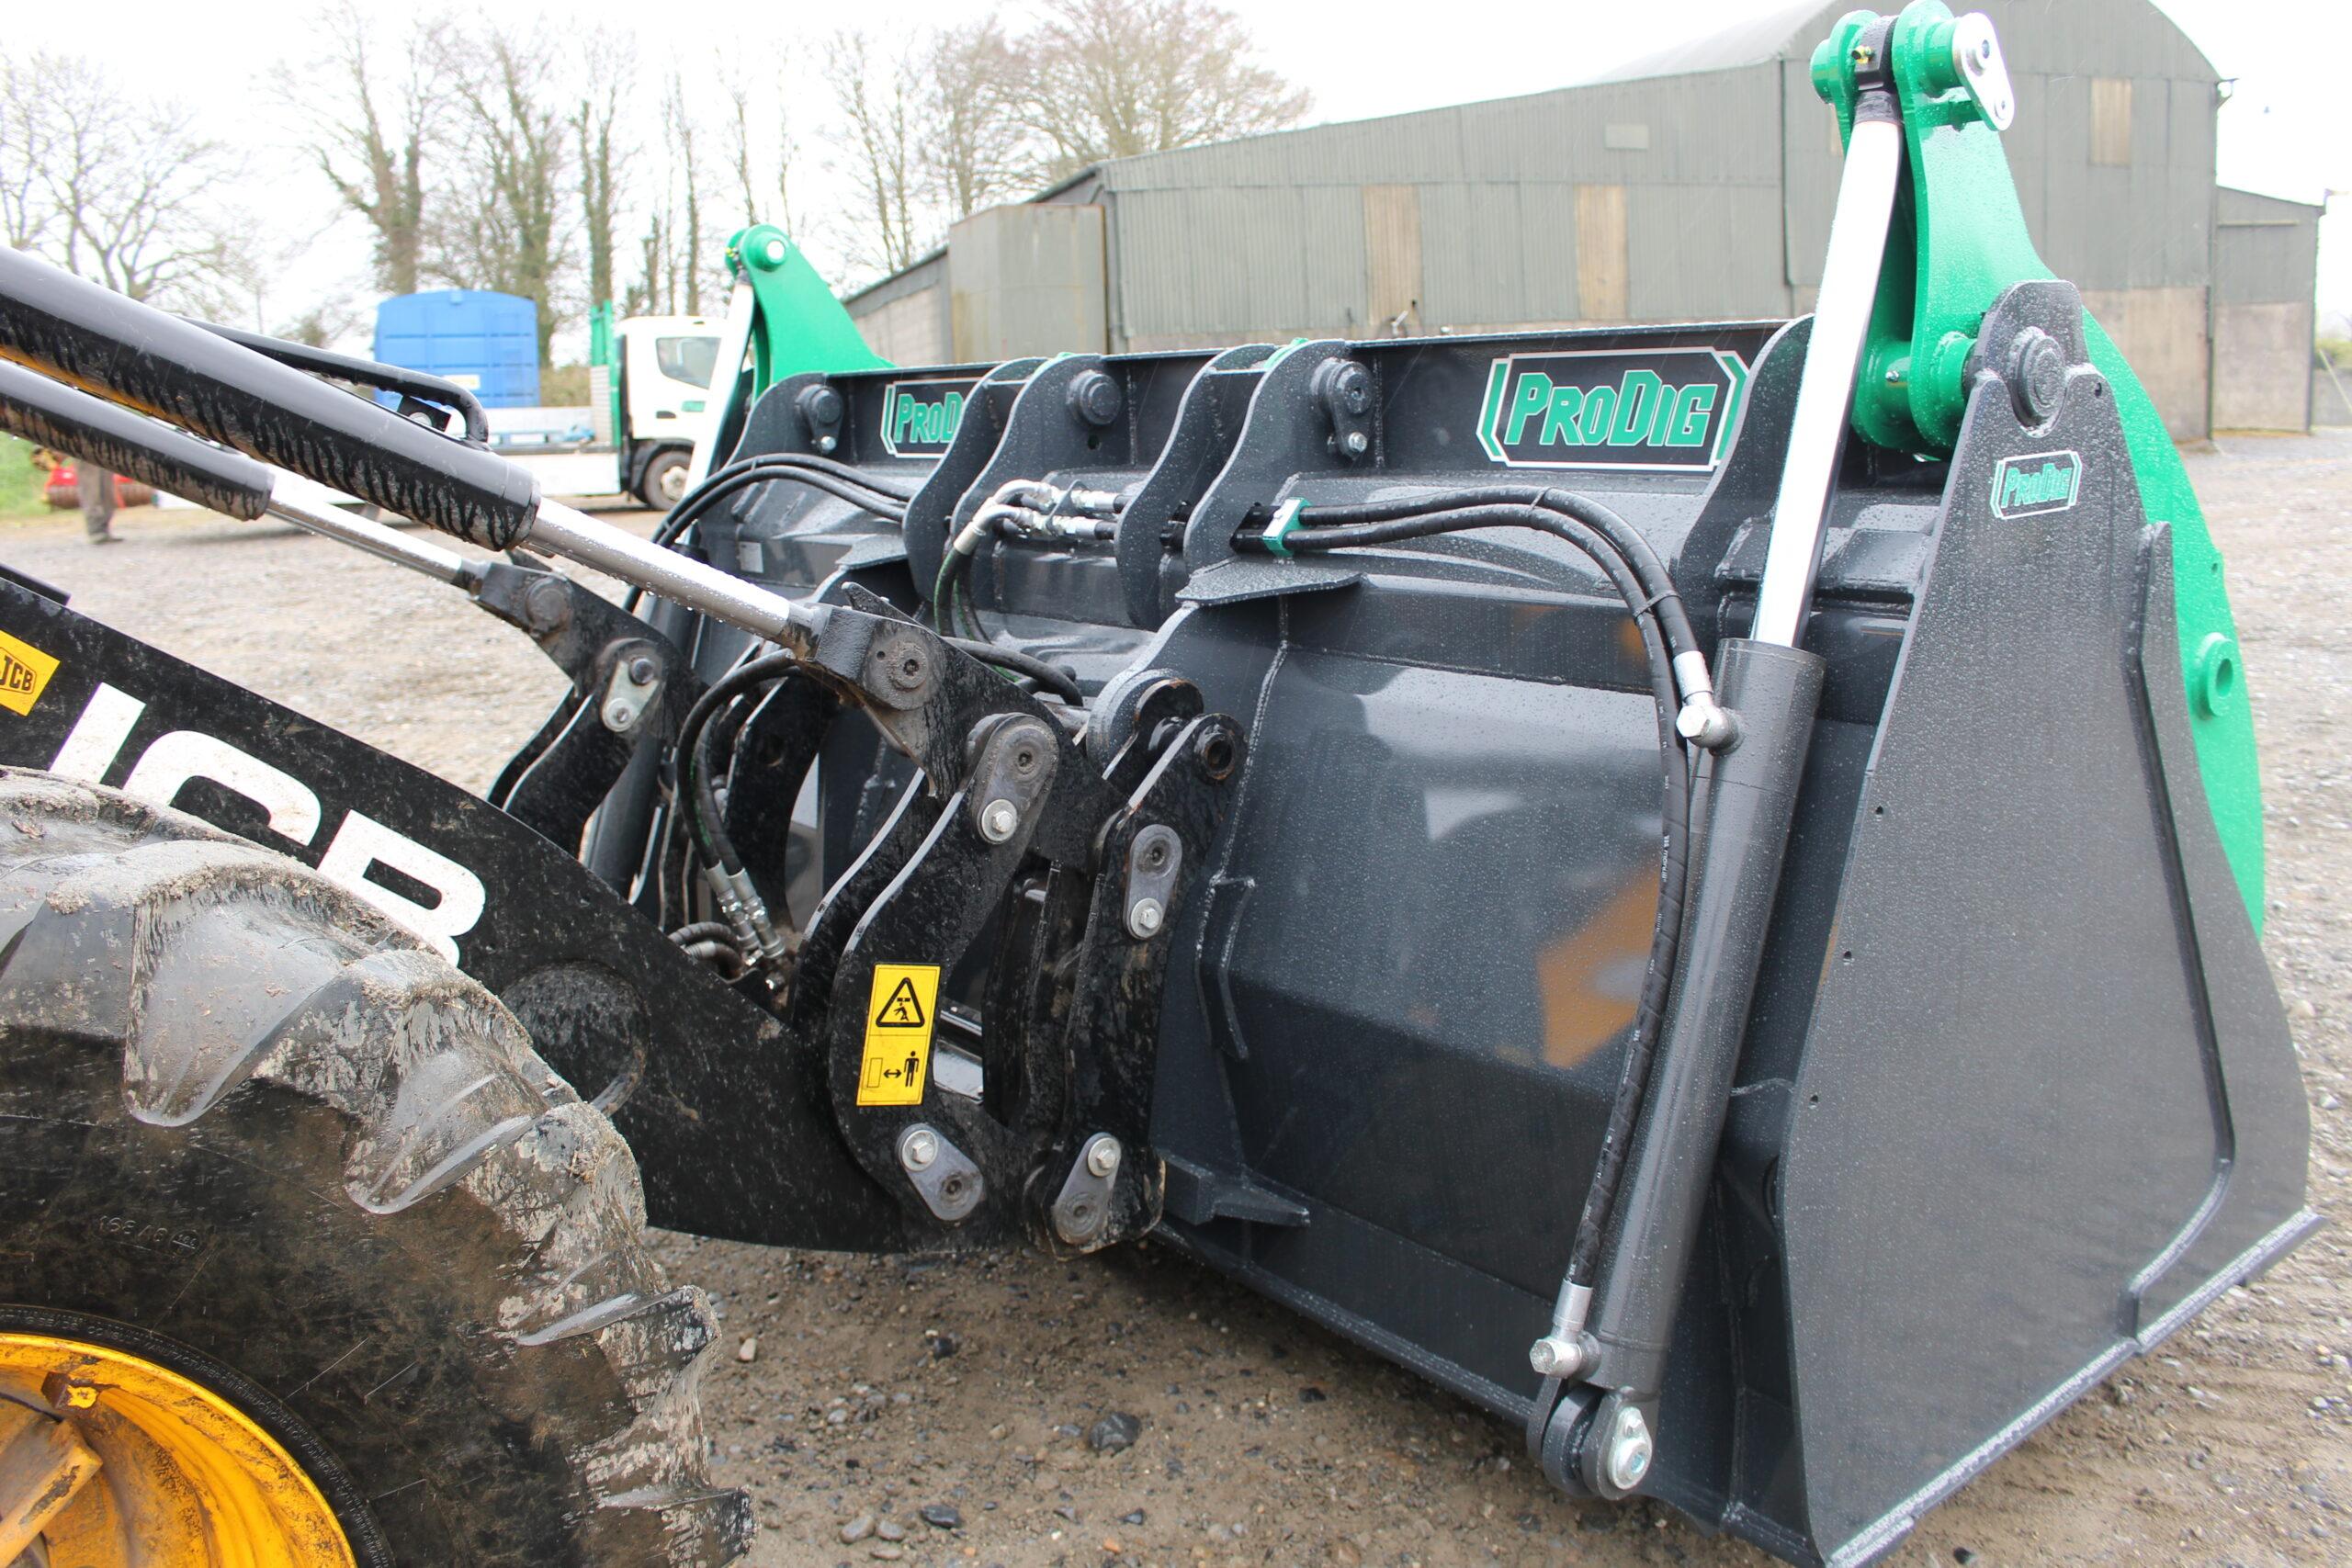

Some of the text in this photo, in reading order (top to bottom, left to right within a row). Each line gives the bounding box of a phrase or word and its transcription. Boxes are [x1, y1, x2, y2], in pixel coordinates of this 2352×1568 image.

[893, 391, 965, 444] PROD
[1503, 369, 1718, 446] PRODIG
[0, 654, 34, 692] JCB
